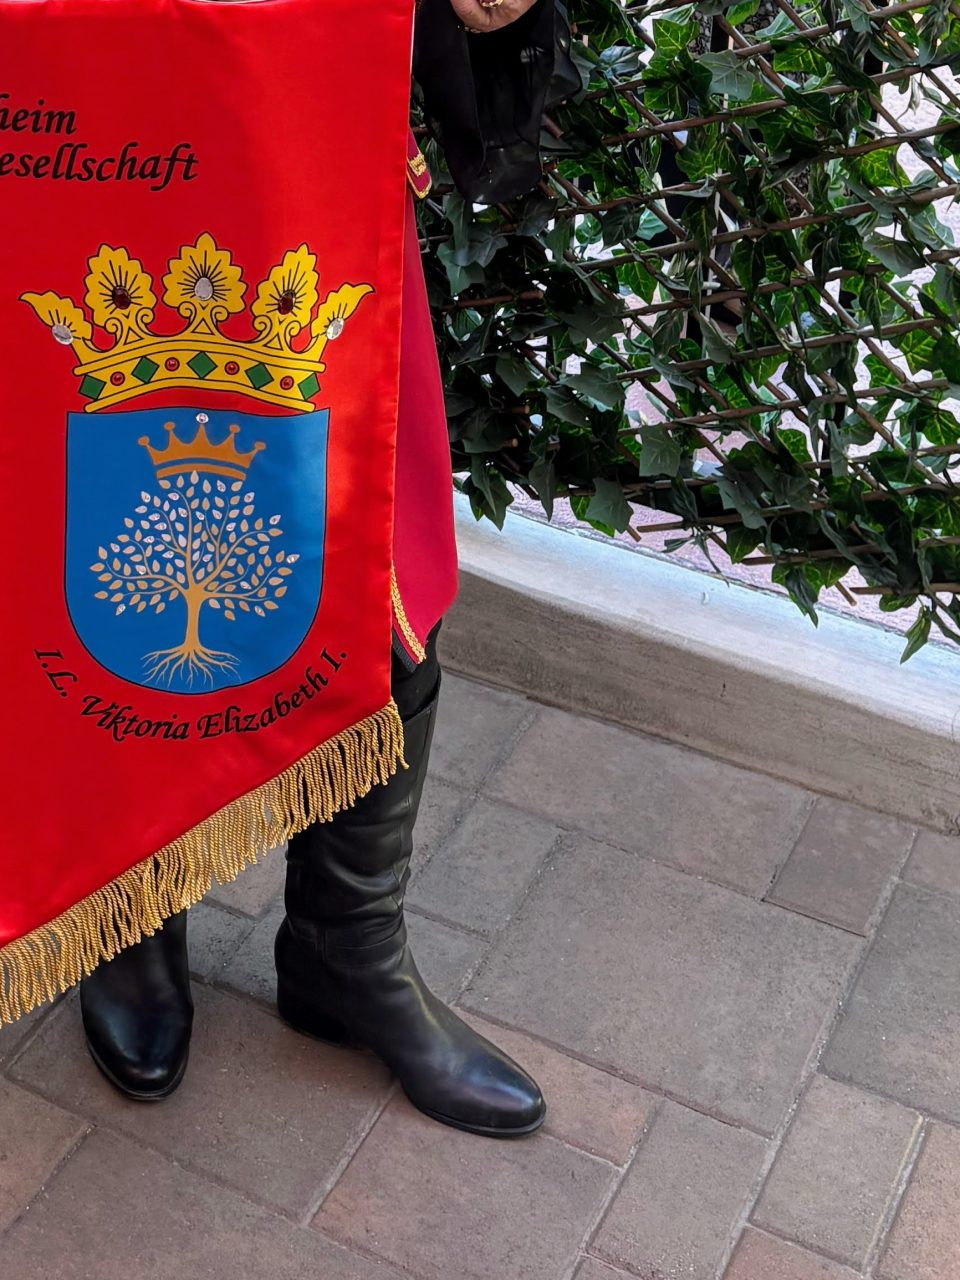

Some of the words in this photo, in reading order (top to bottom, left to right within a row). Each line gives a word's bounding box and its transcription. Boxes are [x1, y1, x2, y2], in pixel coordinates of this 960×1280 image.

[33, 648, 78, 698] I.L.
[81, 695, 189, 742] Viktoria
[197, 671, 329, 739] Elizabeth
[320, 647, 348, 673] I.
